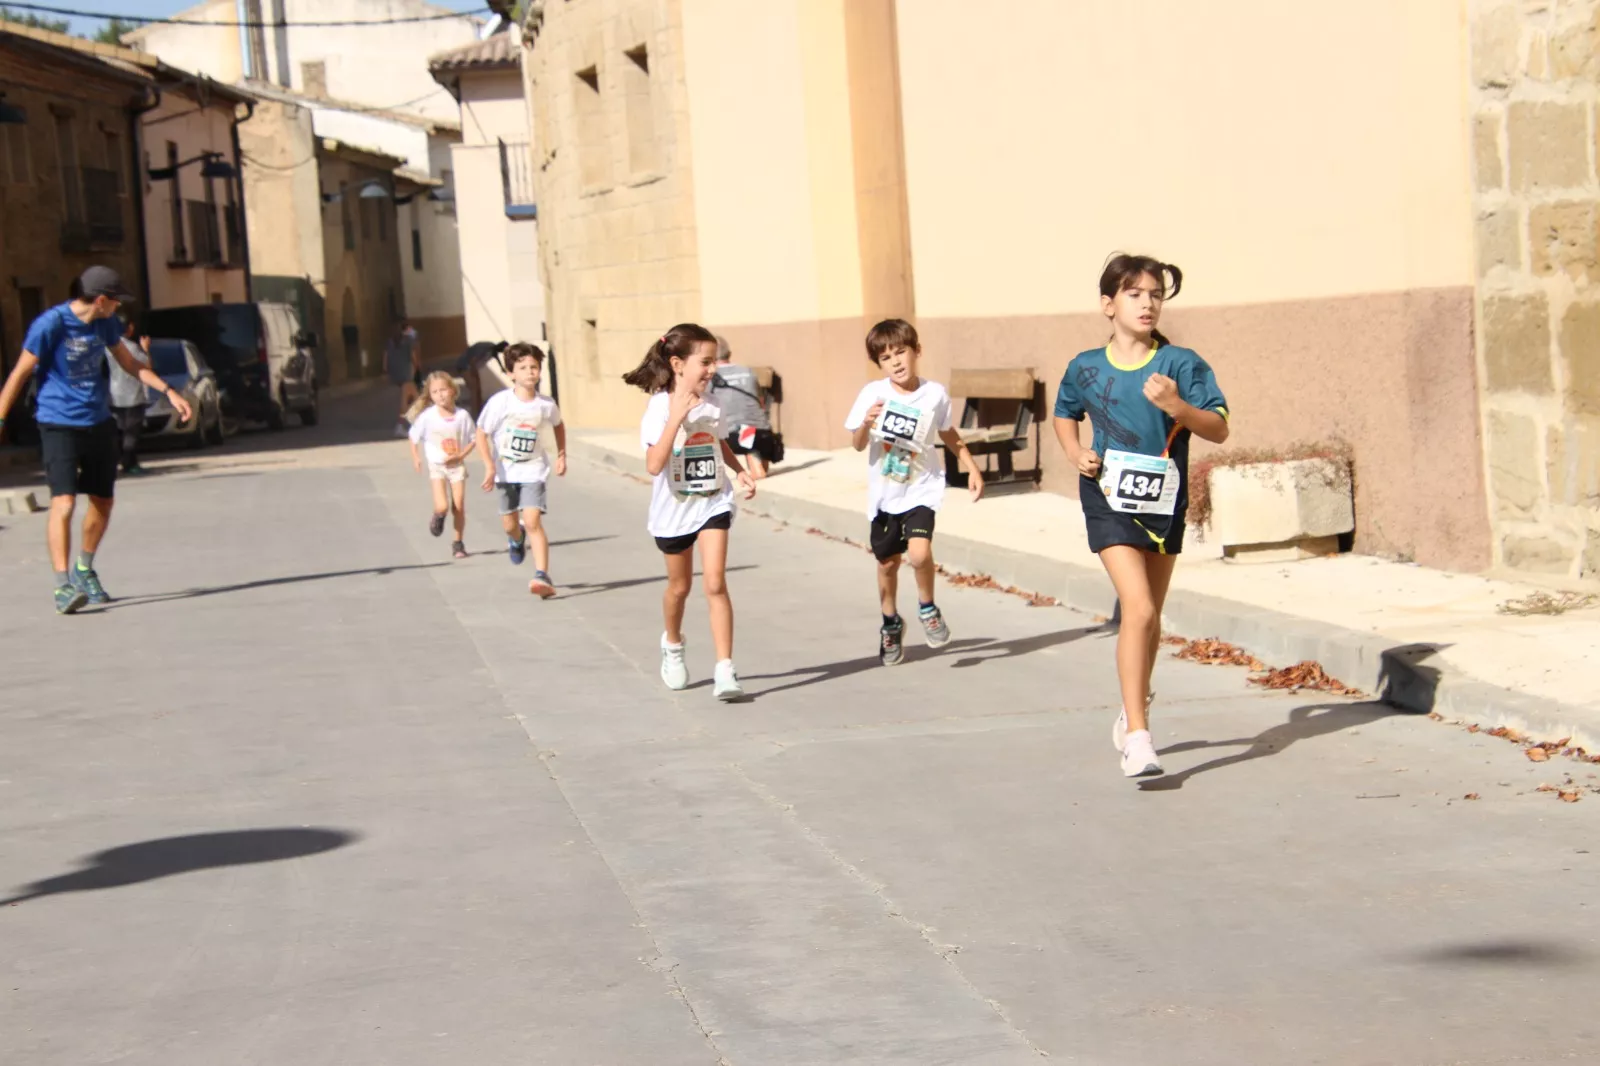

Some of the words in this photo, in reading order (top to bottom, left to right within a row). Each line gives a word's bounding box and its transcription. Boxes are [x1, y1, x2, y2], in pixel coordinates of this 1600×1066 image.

[884, 415, 916, 436] 425
[686, 460, 715, 477] 430
[1120, 474, 1161, 497] 434
